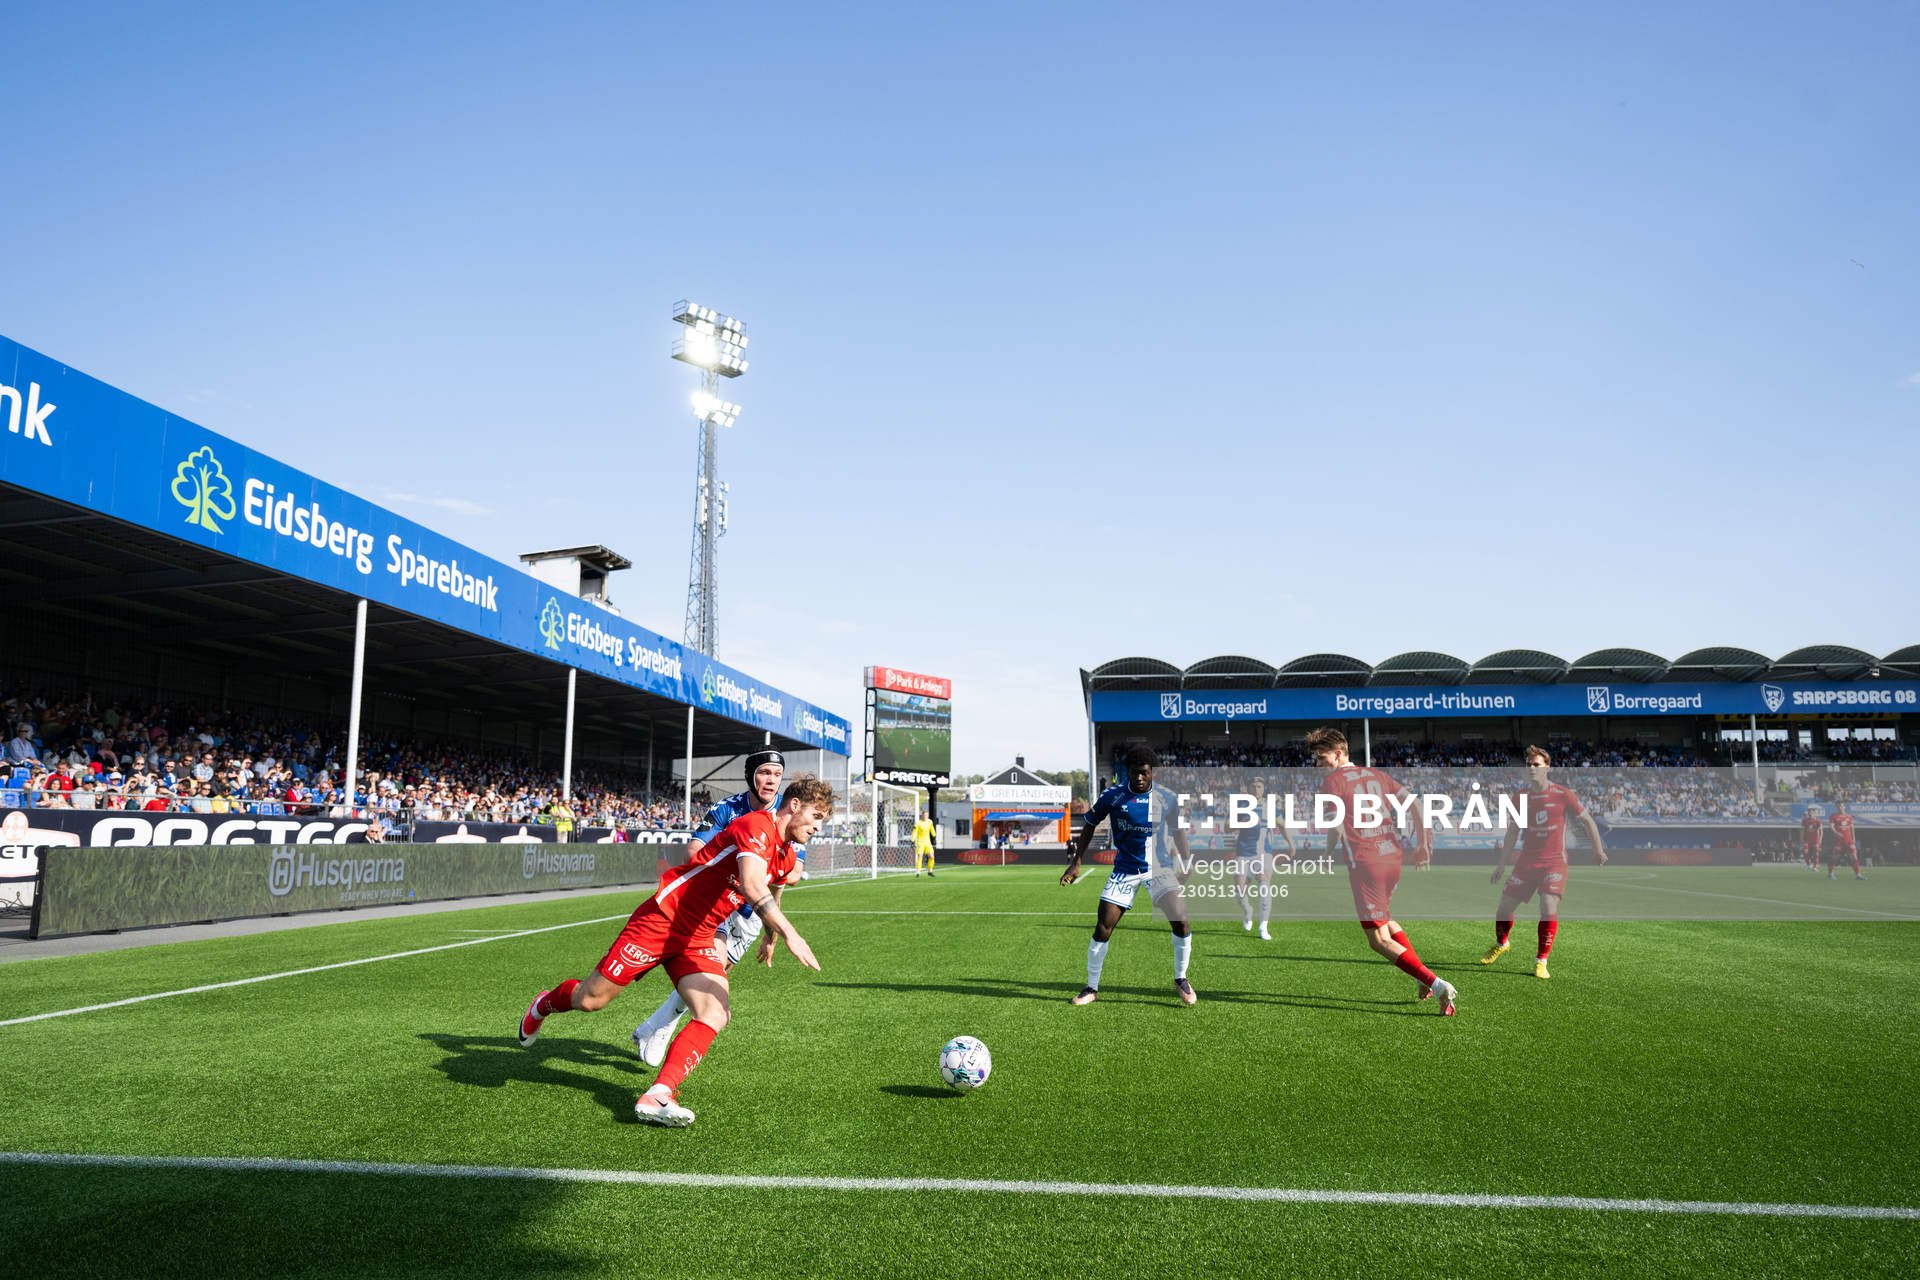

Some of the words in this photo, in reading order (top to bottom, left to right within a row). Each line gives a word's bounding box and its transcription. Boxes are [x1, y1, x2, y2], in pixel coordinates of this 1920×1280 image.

[243, 477, 374, 575] Eidsberg
[386, 534, 499, 613] Sparebank
[567, 612, 624, 667] Eidsberg
[627, 636, 682, 681] Sparebank
[716, 674, 748, 711] Eidsberg
[749, 687, 783, 720] Sparebank
[1185, 698, 1267, 718] Borregaard
[1335, 692, 1516, 715] Borregaard-tribunen
[1613, 692, 1703, 713] Borregaard
[1792, 689, 1892, 705] SARPSBORG
[1894, 689, 1917, 705] 08
[889, 771, 937, 785] PRETEC
[297, 852, 405, 890] Husqvarna
[537, 848, 596, 877] Husqvarna
[608, 959, 625, 977] 16
